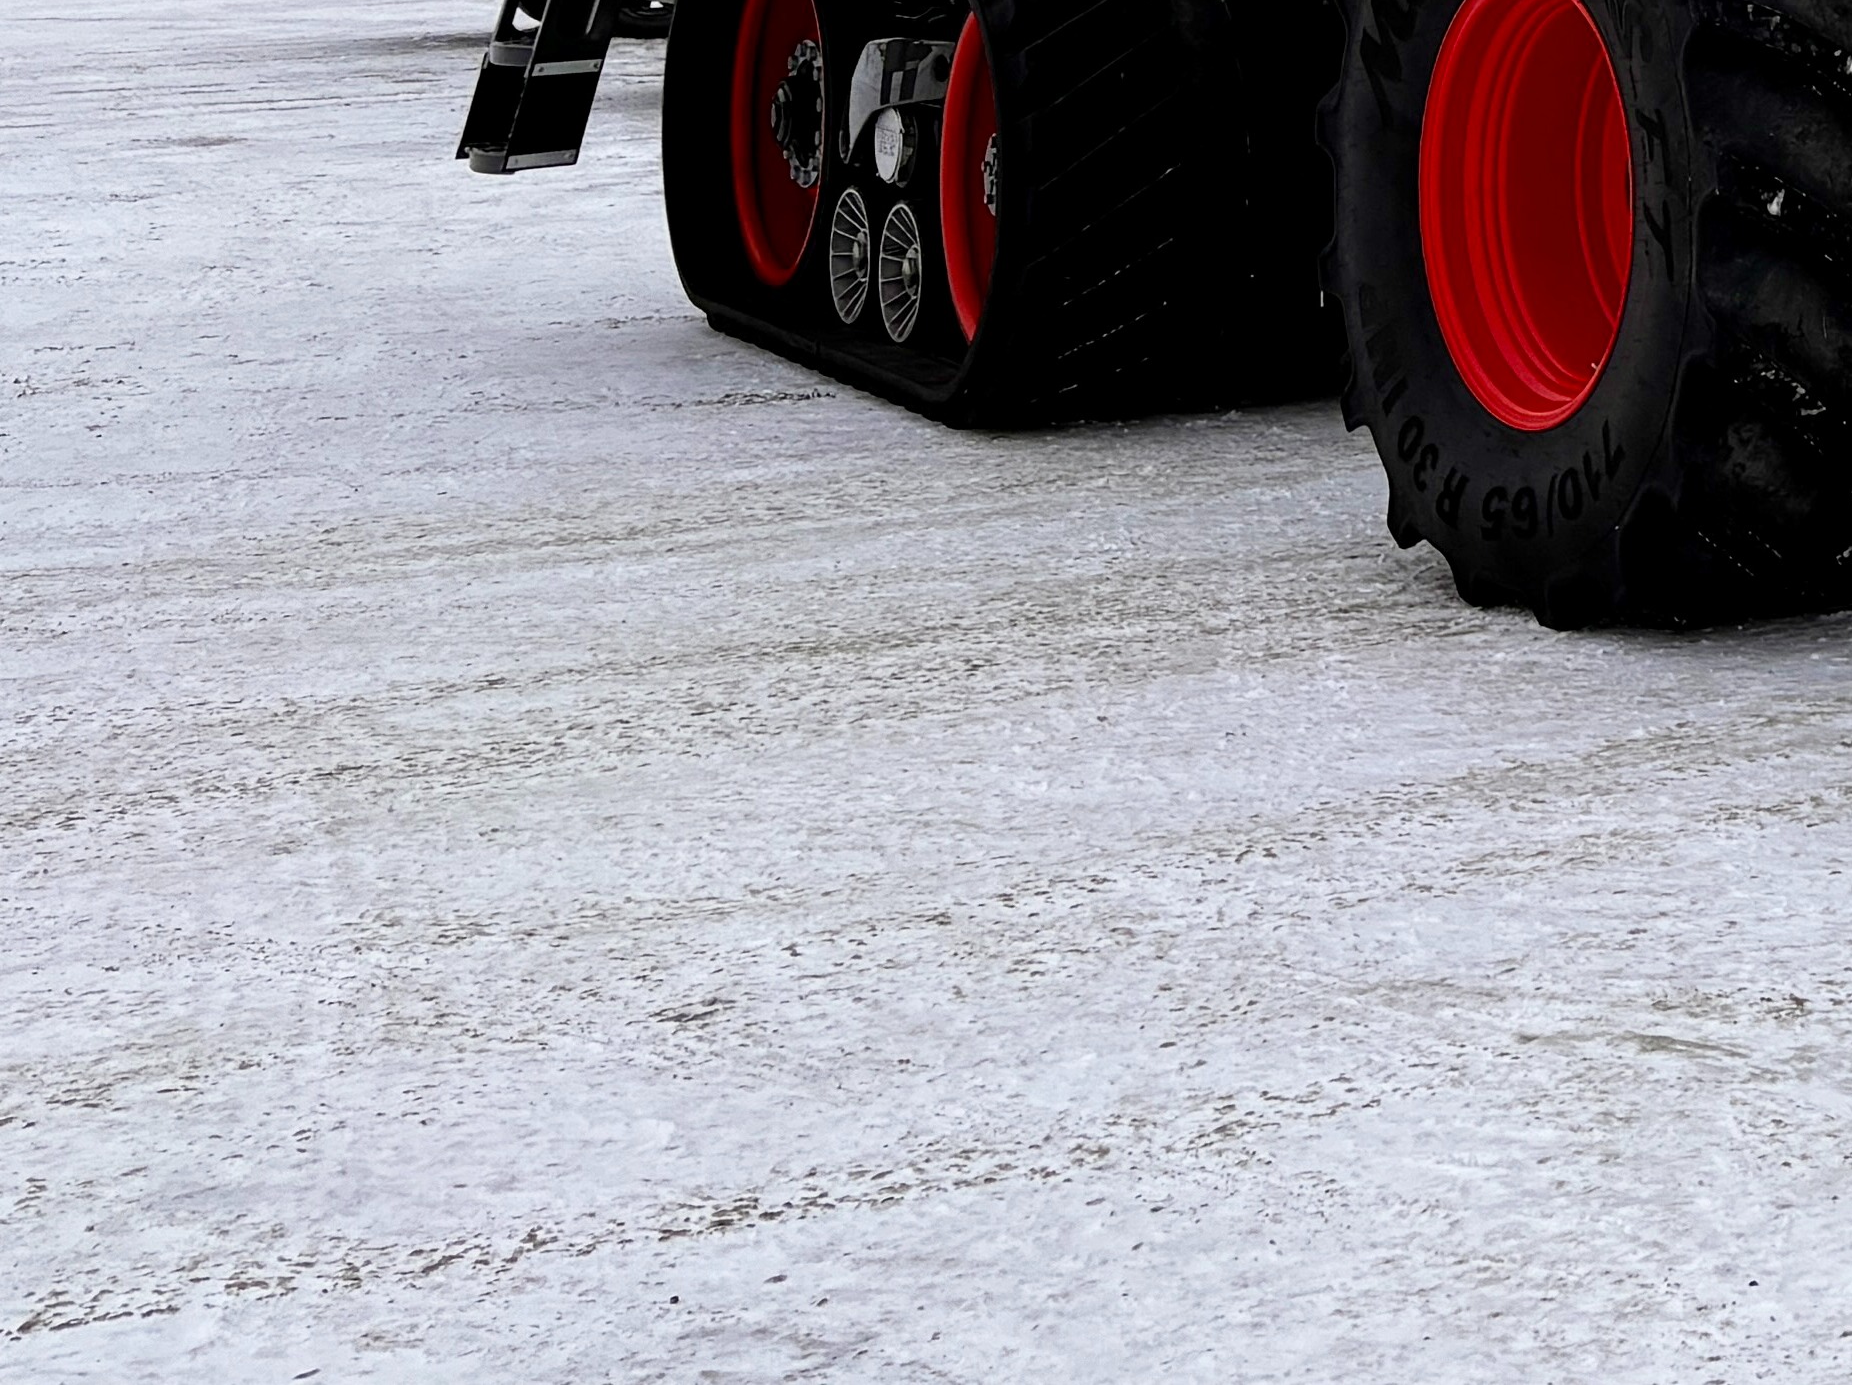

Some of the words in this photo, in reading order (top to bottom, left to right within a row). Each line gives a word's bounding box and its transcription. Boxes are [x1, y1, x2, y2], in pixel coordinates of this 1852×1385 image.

[1397, 415, 1439, 492] 30
[1480, 418, 1626, 541] 710/65
[1435, 466, 1471, 531] R
